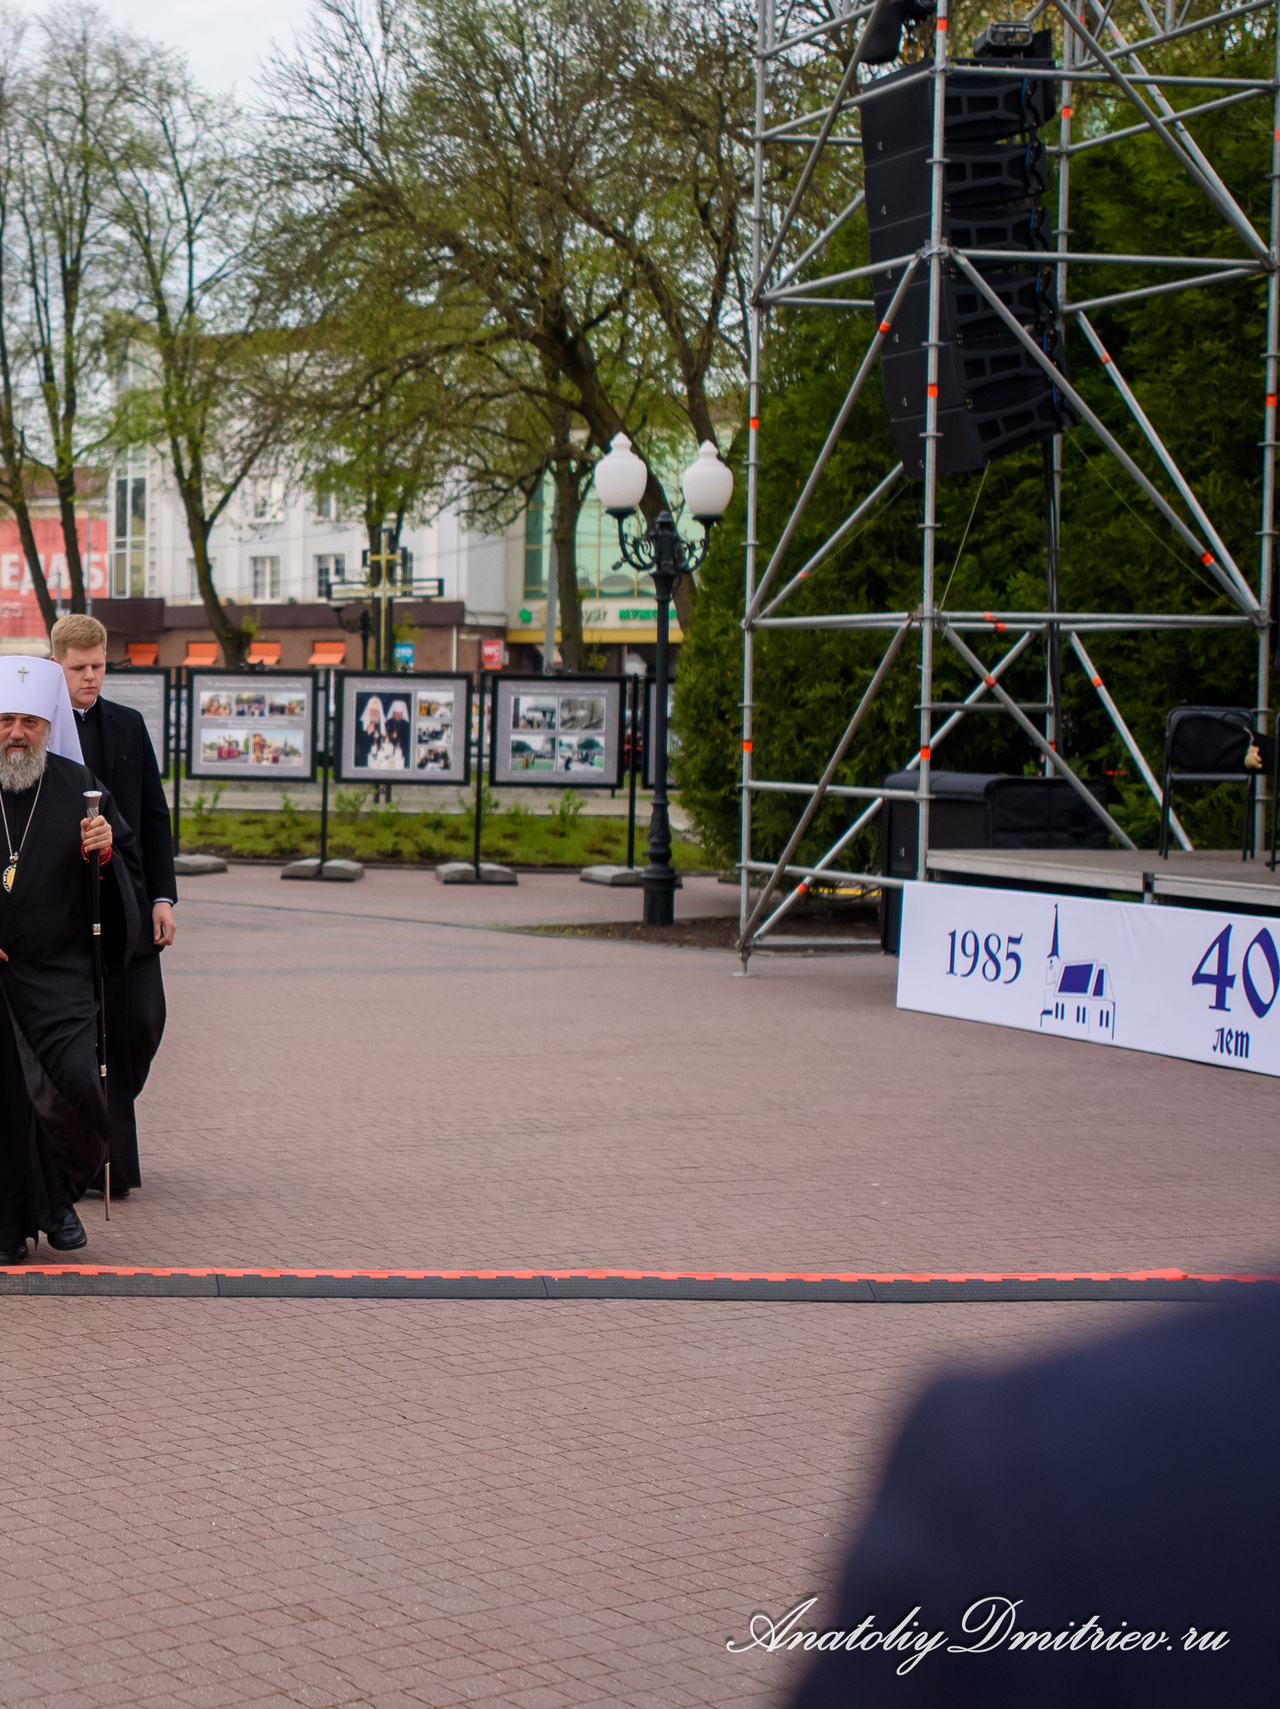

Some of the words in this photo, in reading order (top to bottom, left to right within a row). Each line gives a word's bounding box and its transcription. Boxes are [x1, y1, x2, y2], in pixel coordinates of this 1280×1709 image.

[945, 928, 1024, 984] 1985
[1191, 923, 1280, 1018] 40
[1212, 1027, 1251, 1059] лет
